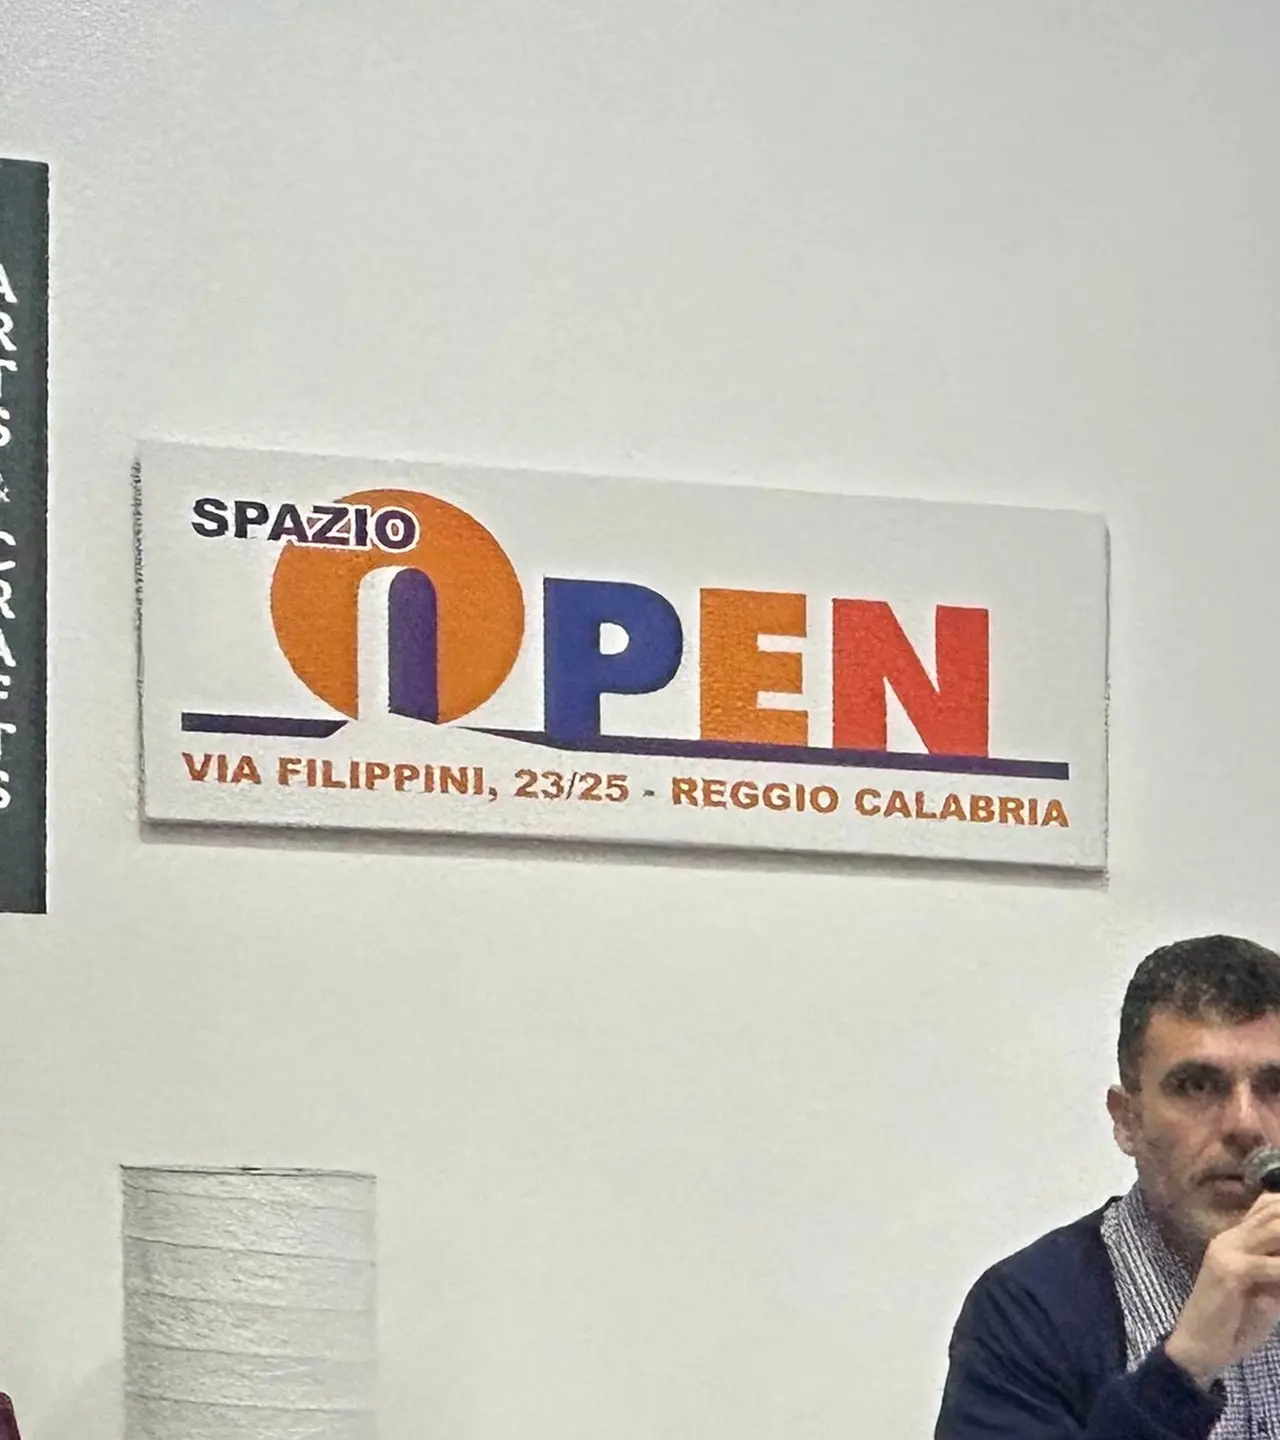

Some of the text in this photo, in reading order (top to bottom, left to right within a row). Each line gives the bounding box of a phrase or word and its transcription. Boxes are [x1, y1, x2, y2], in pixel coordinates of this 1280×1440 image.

[191, 497, 418, 550] SPAZIO
[182, 751, 262, 787] VIA
[277, 757, 498, 804] FILIPPINI,
[515, 766, 629, 804] 23/25
[671, 776, 838, 815] REGGIO
[855, 787, 1069, 829] CALABRIA
